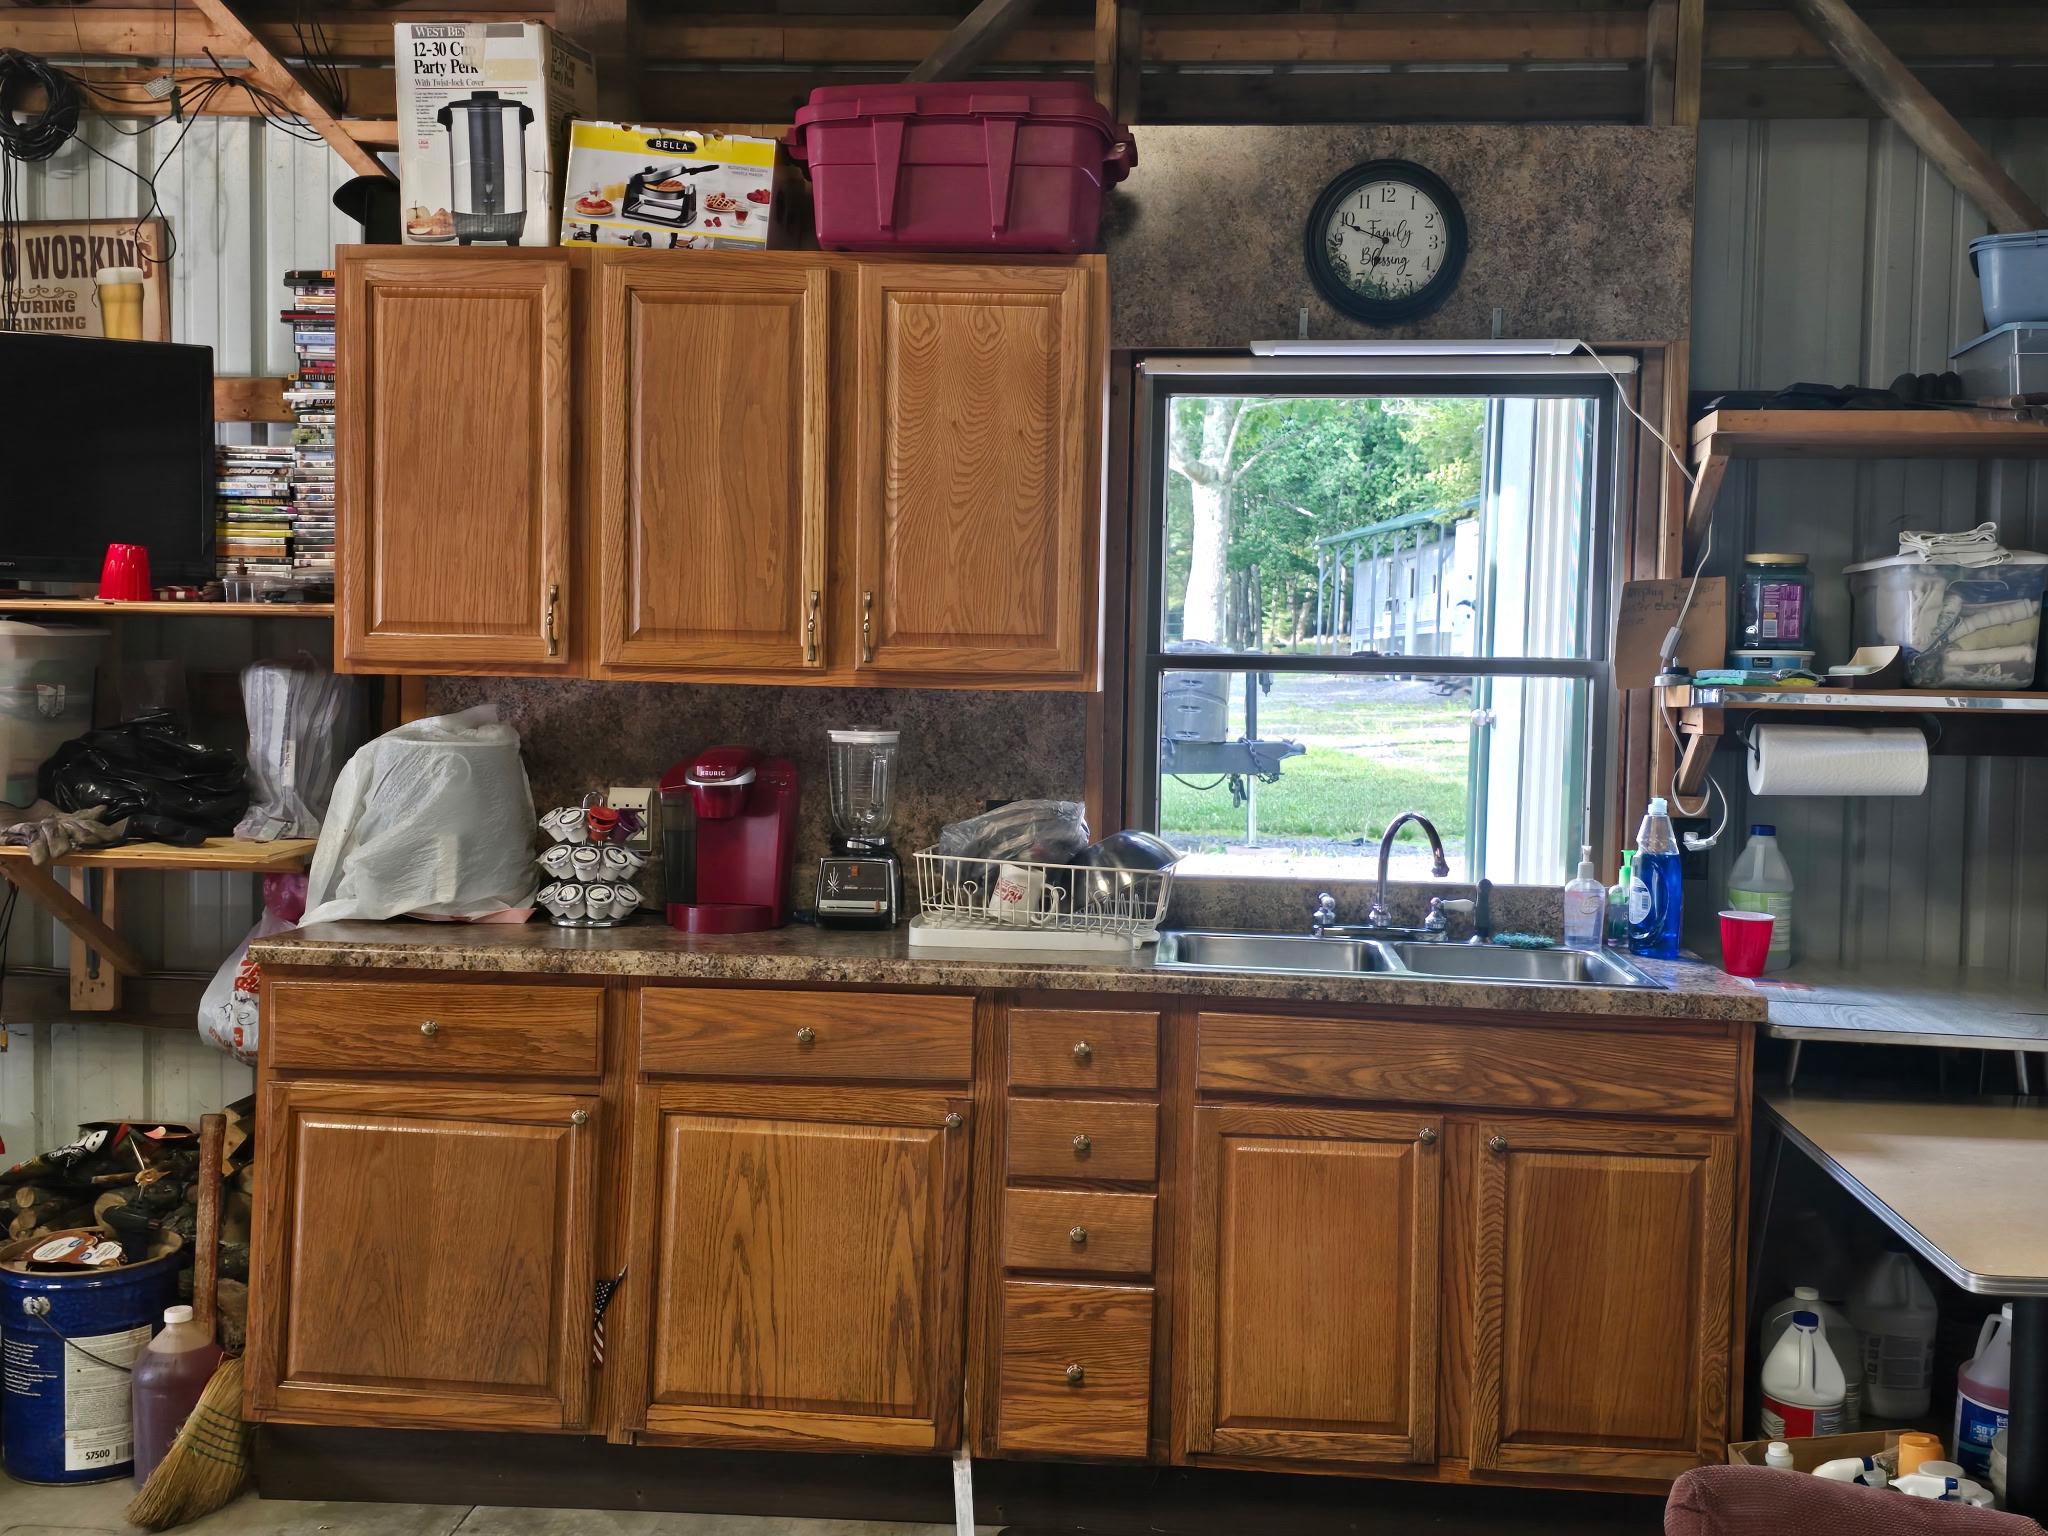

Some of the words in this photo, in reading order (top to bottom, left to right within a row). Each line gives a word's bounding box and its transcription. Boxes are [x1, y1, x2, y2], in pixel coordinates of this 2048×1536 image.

[415, 26, 445, 37] WEST
[448, 26, 467, 37] BEN
[413, 41, 447, 57] 12-30
[413, 59, 447, 77] Party
[450, 58, 479, 74] Perk
[414, 78, 431, 87] With
[431, 78, 465, 88] Twist-lock
[466, 79, 485, 87] Cover
[655, 139, 688, 151] BELLA
[1359, 194, 1370, 209] 11
[1381, 187, 1396, 203] 12
[1411, 195, 1415, 210] 1
[1341, 212, 1355, 226] 10
[1424, 213, 1433, 229] 2
[1366, 219, 1413, 249] Family
[1429, 235, 1438, 250] 3
[25, 235, 153, 280] WORKING
[1359, 247, 1410, 275] Blessing
[1421, 255, 1430, 271] 4
[85, 1448, 111, 1461] 57500
